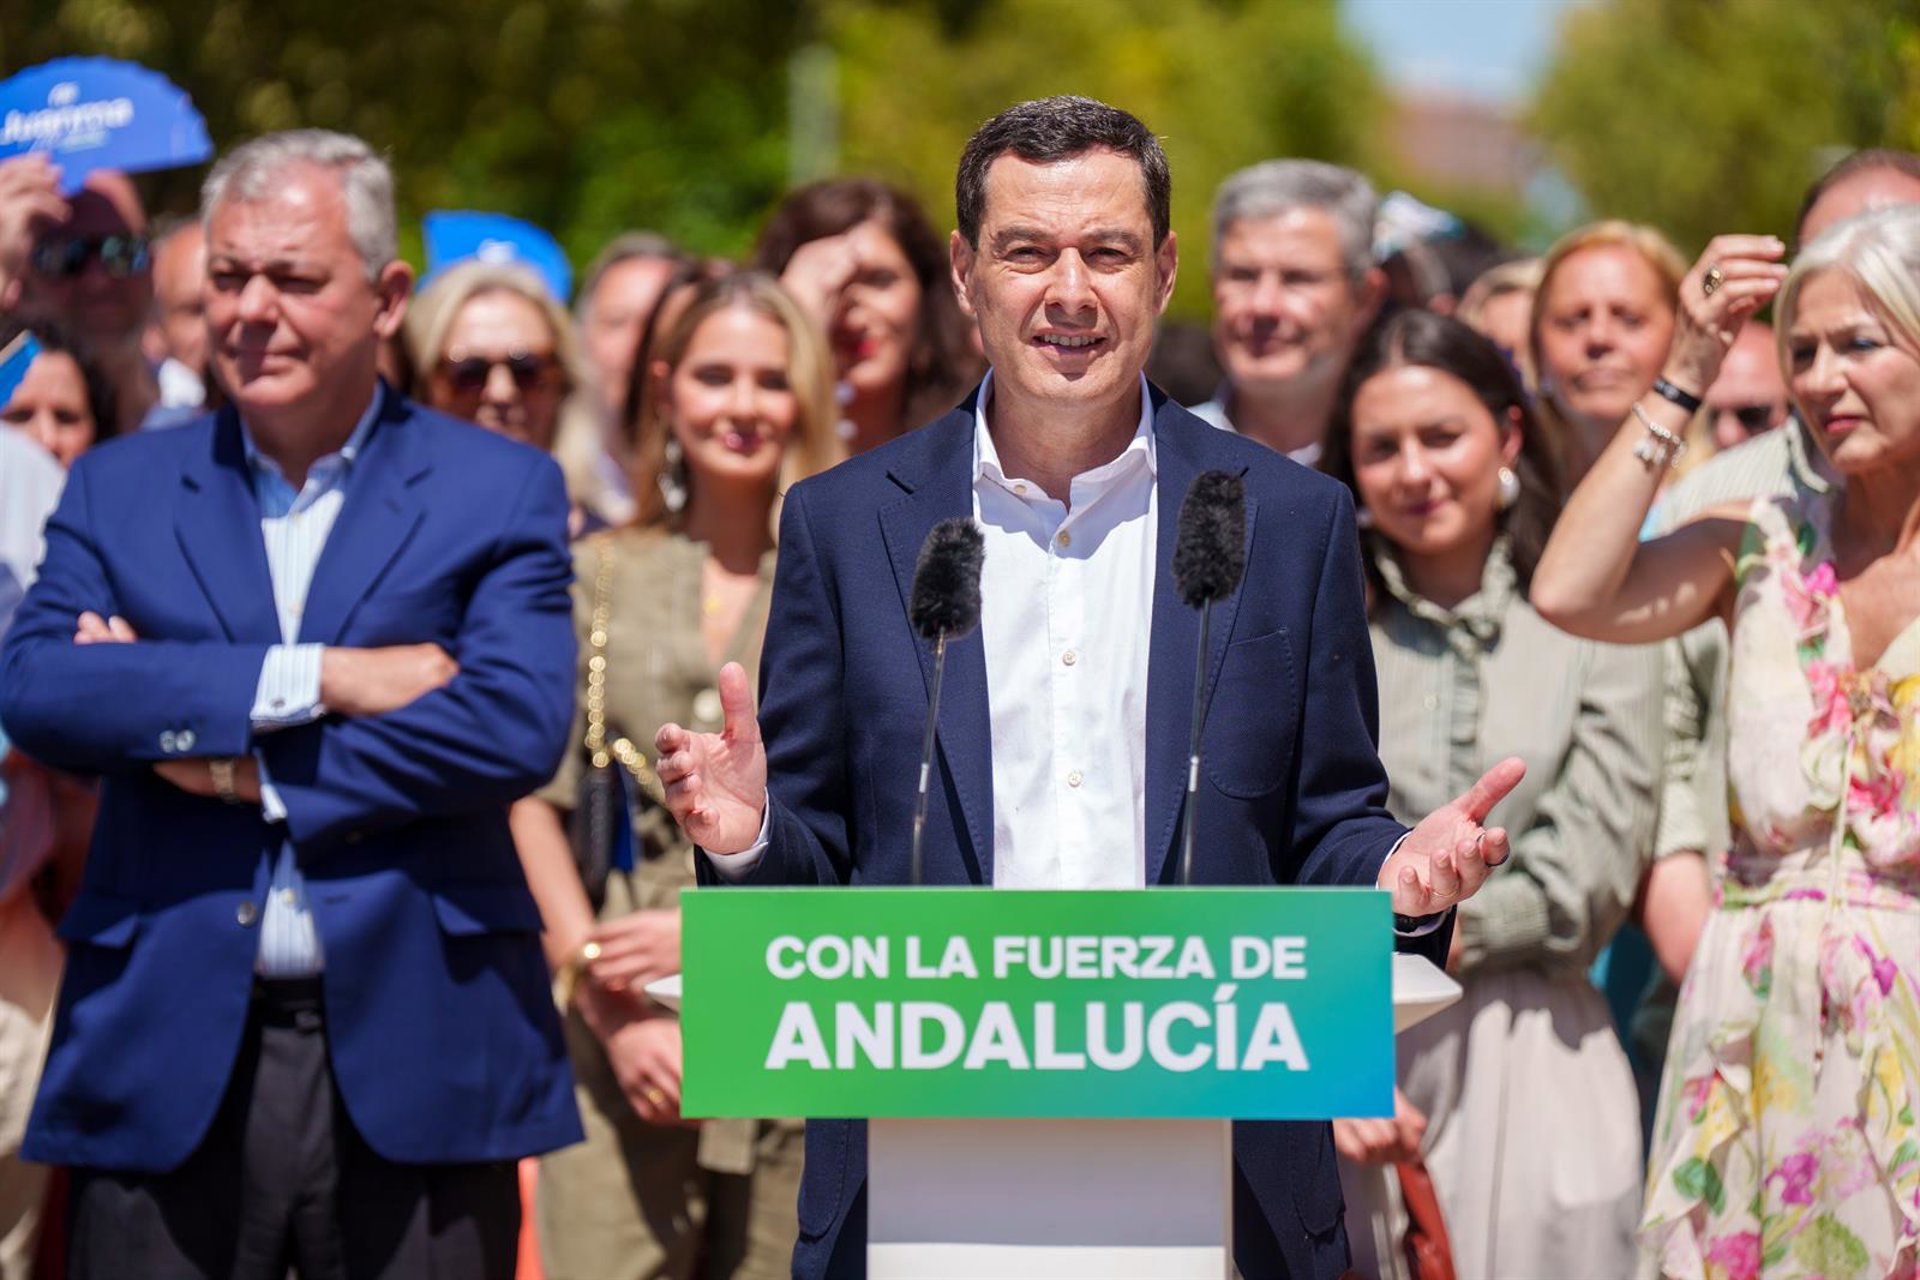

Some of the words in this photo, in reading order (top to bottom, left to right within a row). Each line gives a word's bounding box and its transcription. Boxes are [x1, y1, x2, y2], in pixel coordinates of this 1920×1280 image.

[766, 936, 889, 979] CON
[906, 937, 979, 979] LA
[993, 937, 1215, 979] FUERZA
[1230, 937, 1307, 979] DE
[765, 984, 1309, 1071] ANDALUCÍA
